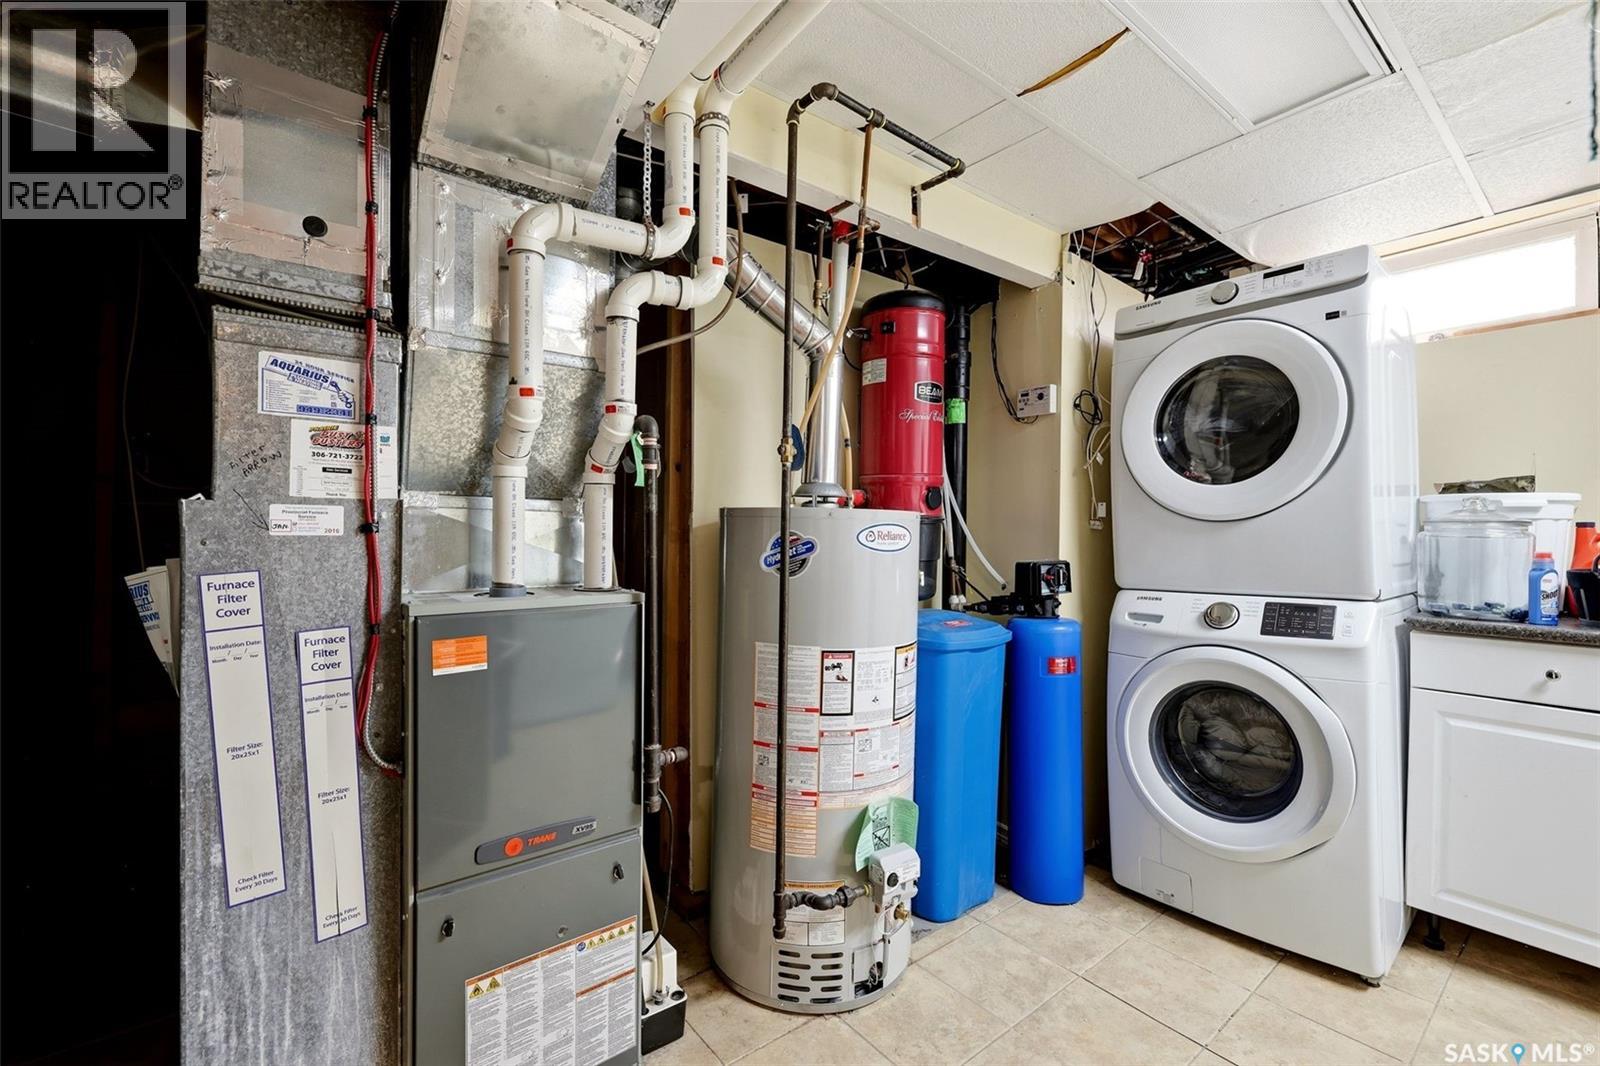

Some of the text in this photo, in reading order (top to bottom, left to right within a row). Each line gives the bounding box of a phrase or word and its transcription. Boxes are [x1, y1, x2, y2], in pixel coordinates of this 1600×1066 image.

[270, 358, 330, 384] AQUARIUS
[876, 530, 907, 542] Reliance
[206, 579, 255, 592] Furnace
[217, 594, 247, 604] Filter
[215, 607, 251, 618] Cover
[209, 641, 245, 652] Installation
[304, 635, 346, 647] Furnace
[312, 648, 339, 659] Filter
[311, 661, 342, 672] Cover
[226, 745, 245, 754] Filter
[231, 749, 260, 761] 20x25x1
[317, 790, 335, 799] Filter
[527, 831, 558, 846] TRANE
[237, 870, 274, 885] Check Filter
[235, 884, 253, 893] Every
[262, 876, 278, 885] Days
[322, 920, 338, 929] Every
